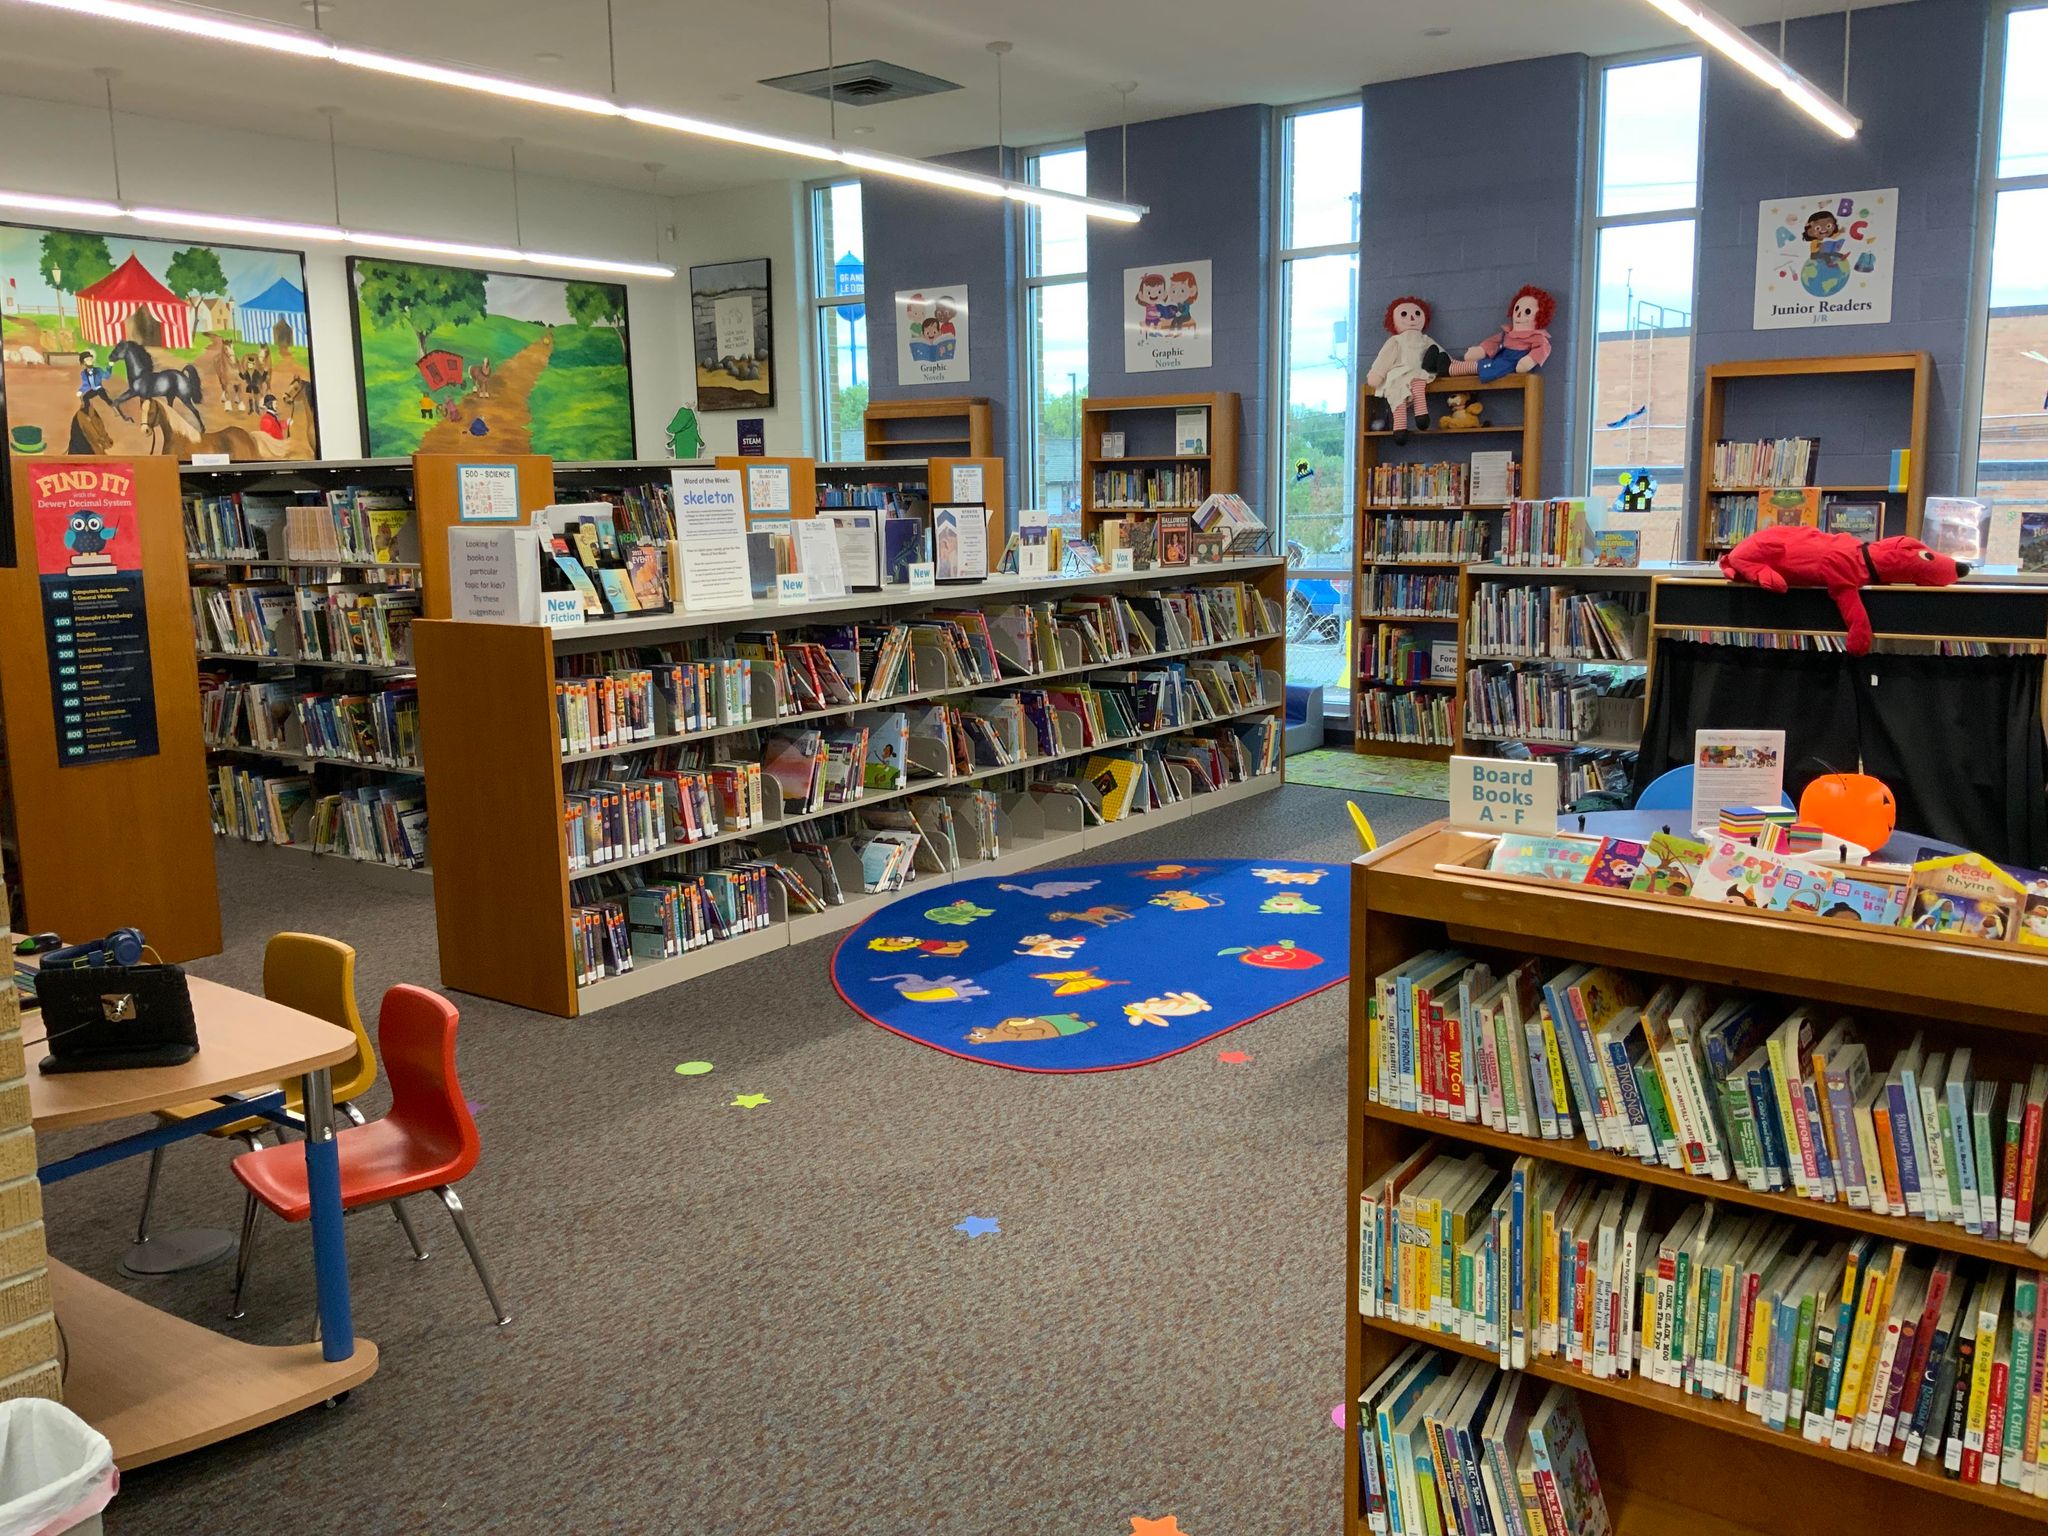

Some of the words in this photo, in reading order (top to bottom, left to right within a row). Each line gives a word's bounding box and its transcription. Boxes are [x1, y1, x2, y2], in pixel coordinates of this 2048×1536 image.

[1837, 198, 1854, 217] B
[1776, 226, 1797, 248] A
[1849, 220, 1868, 240] C
[1771, 304, 1814, 316] Junior
[1819, 299, 1872, 313] Readers
[1152, 348, 1184, 358] Graphic
[920, 364, 946, 374] Graphic
[1156, 360, 1180, 368] Novels
[485, 470, 510, 478] SCIENCE
[36, 470, 98, 498] FIND
[101, 472, 130, 496] IT!
[38, 500, 67, 508] Dewey
[69, 499, 102, 507] Decimal
[103, 499, 132, 507] System
[683, 490, 735, 505] skeleton
[466, 541, 488, 549] Looking
[489, 540, 498, 548] for
[467, 554, 485, 562] books
[1117, 553, 1128, 562] Vox
[470, 568, 498, 577] particular
[914, 569, 930, 578] New
[465, 581, 479, 590] topic
[490, 580, 506, 589] kids?
[783, 580, 803, 590] New
[469, 609, 505, 617] suggestions!
[548, 599, 576, 611] New
[56, 618, 70, 626] 100
[551, 612, 580, 622] Fiction
[64, 699, 79, 707] 600
[1473, 766, 1533, 786] Board
[1472, 786, 1533, 806] Books
[1480, 806, 1493, 822] A
[1515, 809, 1524, 824] F
[1952, 863, 1992, 880] Read
[1947, 874, 1996, 893] Rhyme
[1582, 1031, 1595, 1061] KINDNESS
[1402, 1041, 1410, 1073] PRONOUN
[1449, 1051, 1460, 1070] My
[1451, 1073, 1461, 1097] Car
[1502, 1061, 1512, 1090] BUTTON
[1659, 1107, 1670, 1132] Trucks
[1927, 1112, 1938, 1130] Your
[1796, 1108, 1809, 1148] CLIFFORD
[1805, 1150, 1816, 1177] LOVES
[1838, 1110, 1848, 1139] Arthur's
[1843, 1142, 1852, 1158] New
[1895, 1114, 1910, 1153] BARNYARD
[1930, 1133, 1944, 1167] Personal
[1442, 1258, 1450, 1273] MY
[1665, 1285, 1673, 1310] CLICK,
[1663, 1313, 1671, 1341] CLACK,
[1983, 1335, 1992, 1348] My
[2015, 1332, 2029, 1373] PRAYER
[1980, 1351, 1990, 1374] Book
[1875, 1371, 1889, 1393] Lunar
[1979, 1377, 1987, 1387] of
[2013, 1377, 2026, 1399] FOR
[1917, 1385, 1933, 1426] RAMADAN
[1972, 1390, 1986, 1428] Feelings
[2013, 1402, 2023, 1410] A
[1987, 1409, 1997, 1430] LOVE
[2008, 1414, 2022, 1448] CHILD
[1428, 1421, 1438, 1450] QUANTUM
[1434, 1452, 1446, 1486] COMPUTING
[1451, 1458, 1461, 1478] ABCs
[1458, 1485, 1468, 1509] Physics
[1466, 1460, 1476, 1479] ABCs
[1472, 1487, 1481, 1506] Space
[1498, 1451, 1509, 1477] ROCKET
[1506, 1479, 1517, 1507] SCIENCE
[1448, 1481, 1456, 1498] babies
[1548, 1489, 1556, 1503] Days
[1532, 1512, 1542, 1532] Hello
